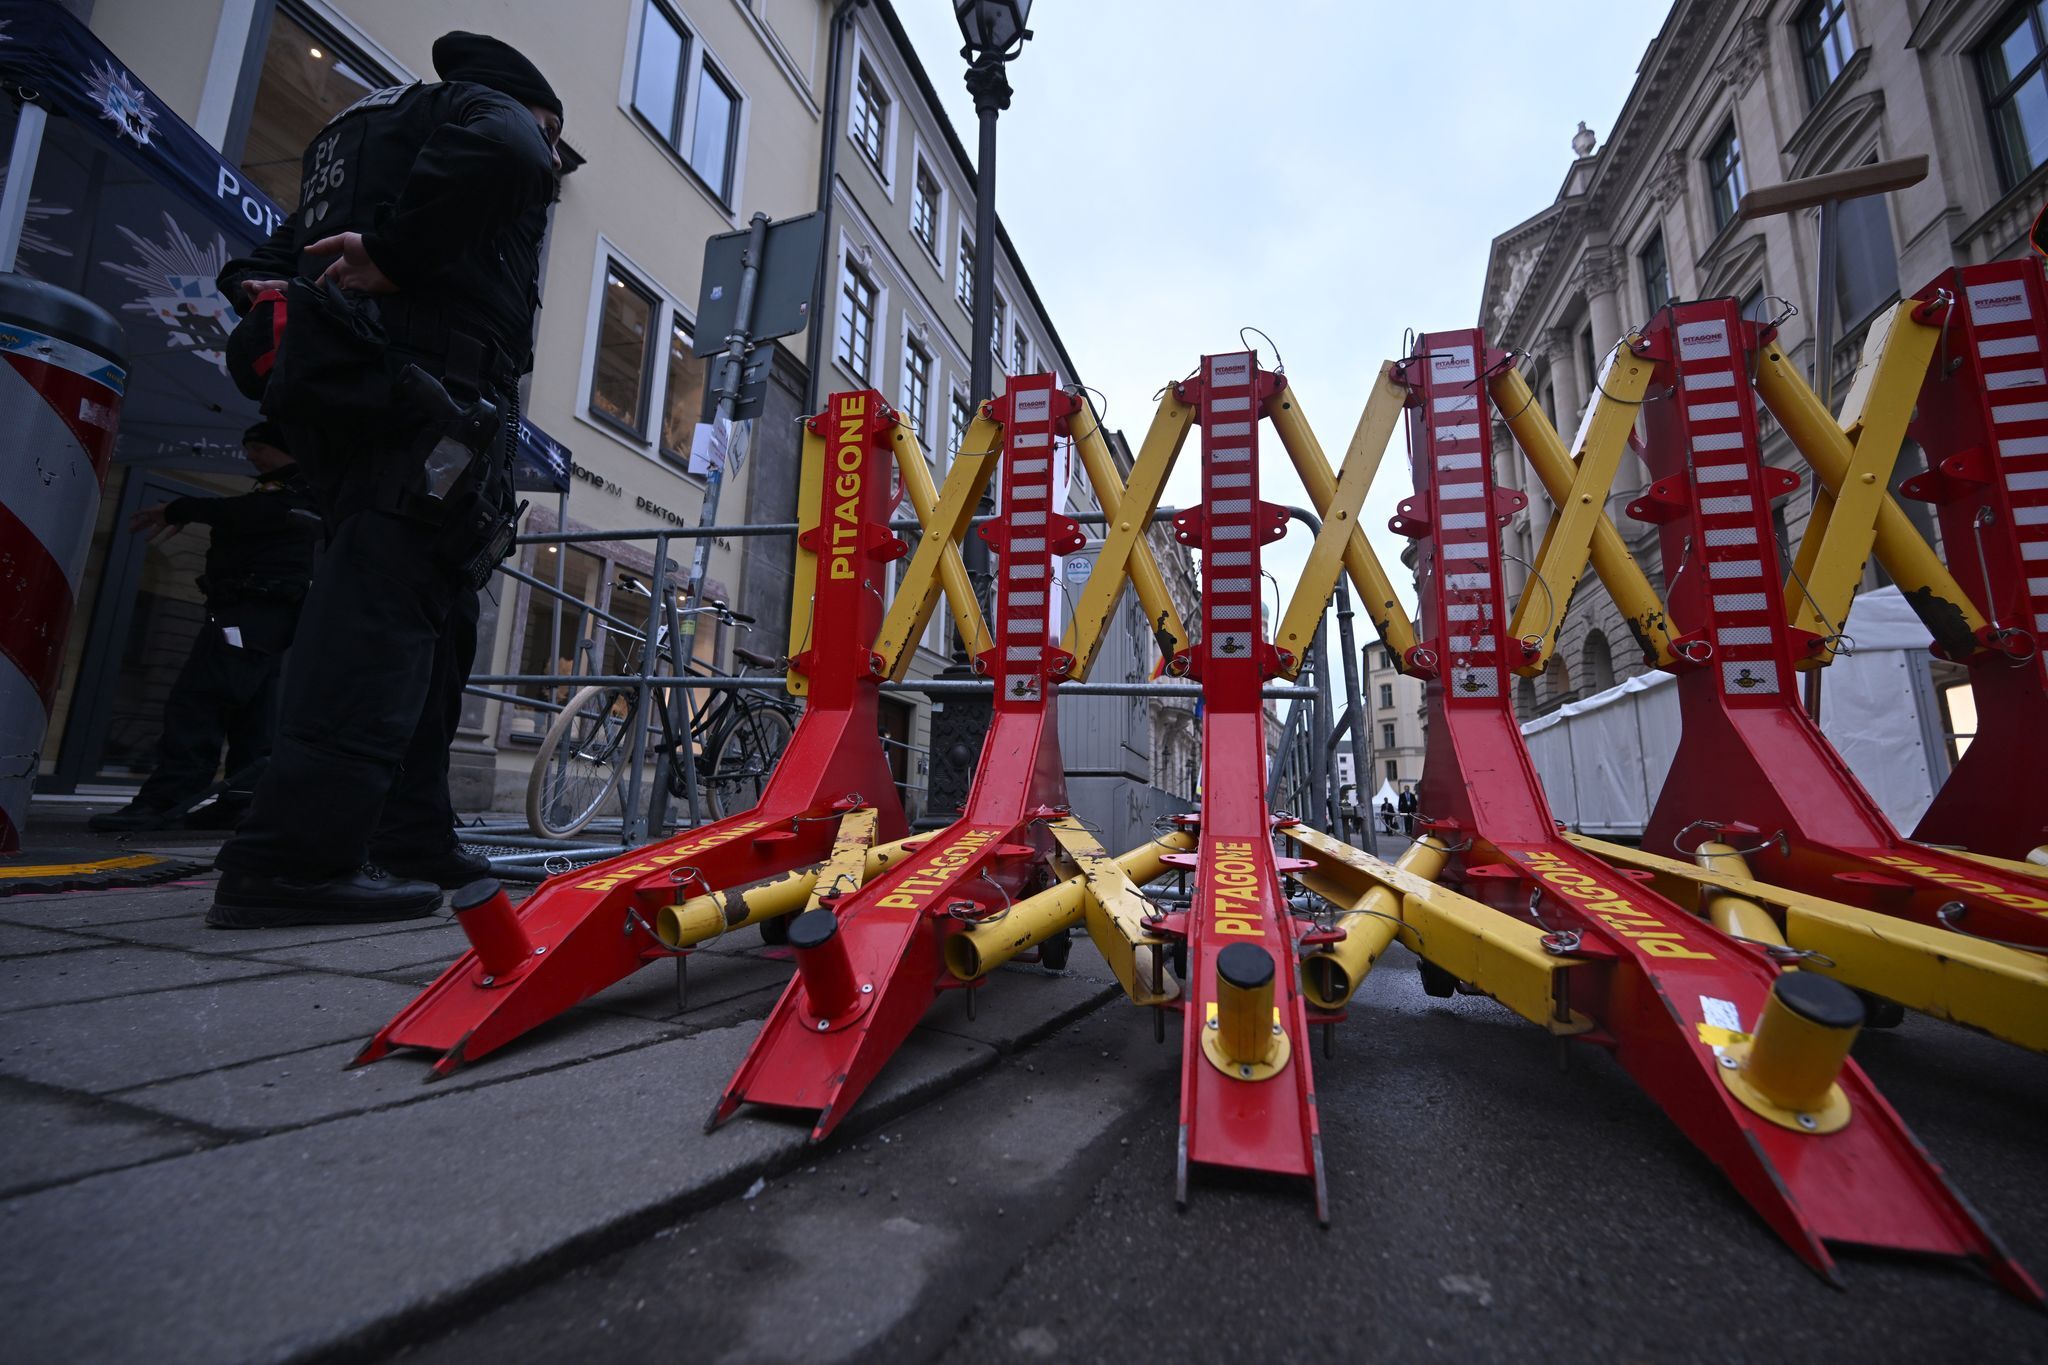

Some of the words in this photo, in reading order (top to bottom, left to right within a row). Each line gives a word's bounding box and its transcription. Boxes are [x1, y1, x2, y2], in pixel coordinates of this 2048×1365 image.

[1974, 295, 2022, 305] PITAGONE
[1682, 333, 1723, 343] PITAGONE
[636, 495, 685, 527] DEKTON
[831, 395, 865, 580] PITAGONE
[576, 821, 769, 891] PITAGONE
[875, 830, 1001, 909] PITAGONE
[1214, 842, 1265, 936] PITAGONE
[1524, 852, 1718, 960] PITAGONE
